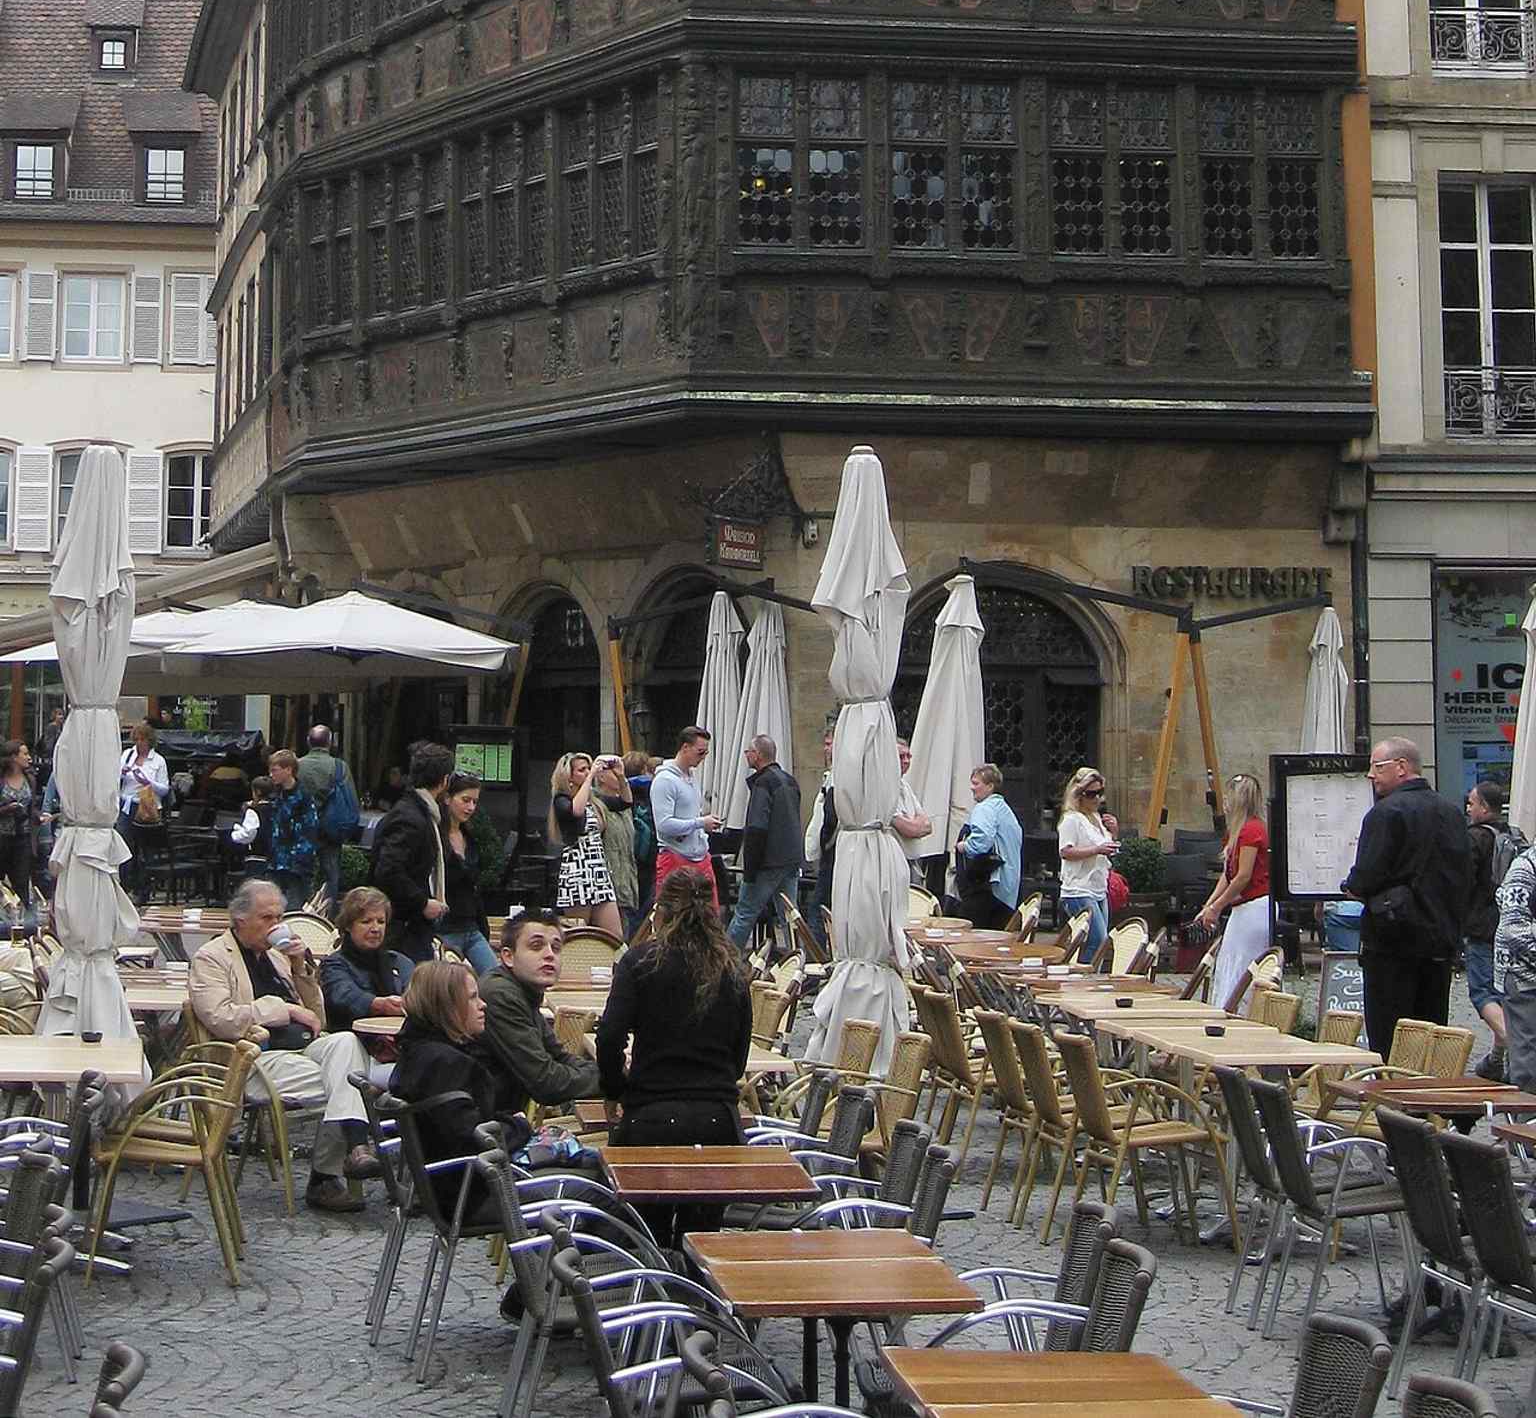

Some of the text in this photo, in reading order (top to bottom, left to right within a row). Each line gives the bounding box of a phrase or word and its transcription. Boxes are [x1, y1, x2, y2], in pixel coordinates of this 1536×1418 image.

[1132, 566, 1333, 599] RESTAURANT
[1443, 692, 1507, 703] HERE
[1445, 705, 1492, 714] Vitrine
[1307, 758, 1353, 769] MENU
